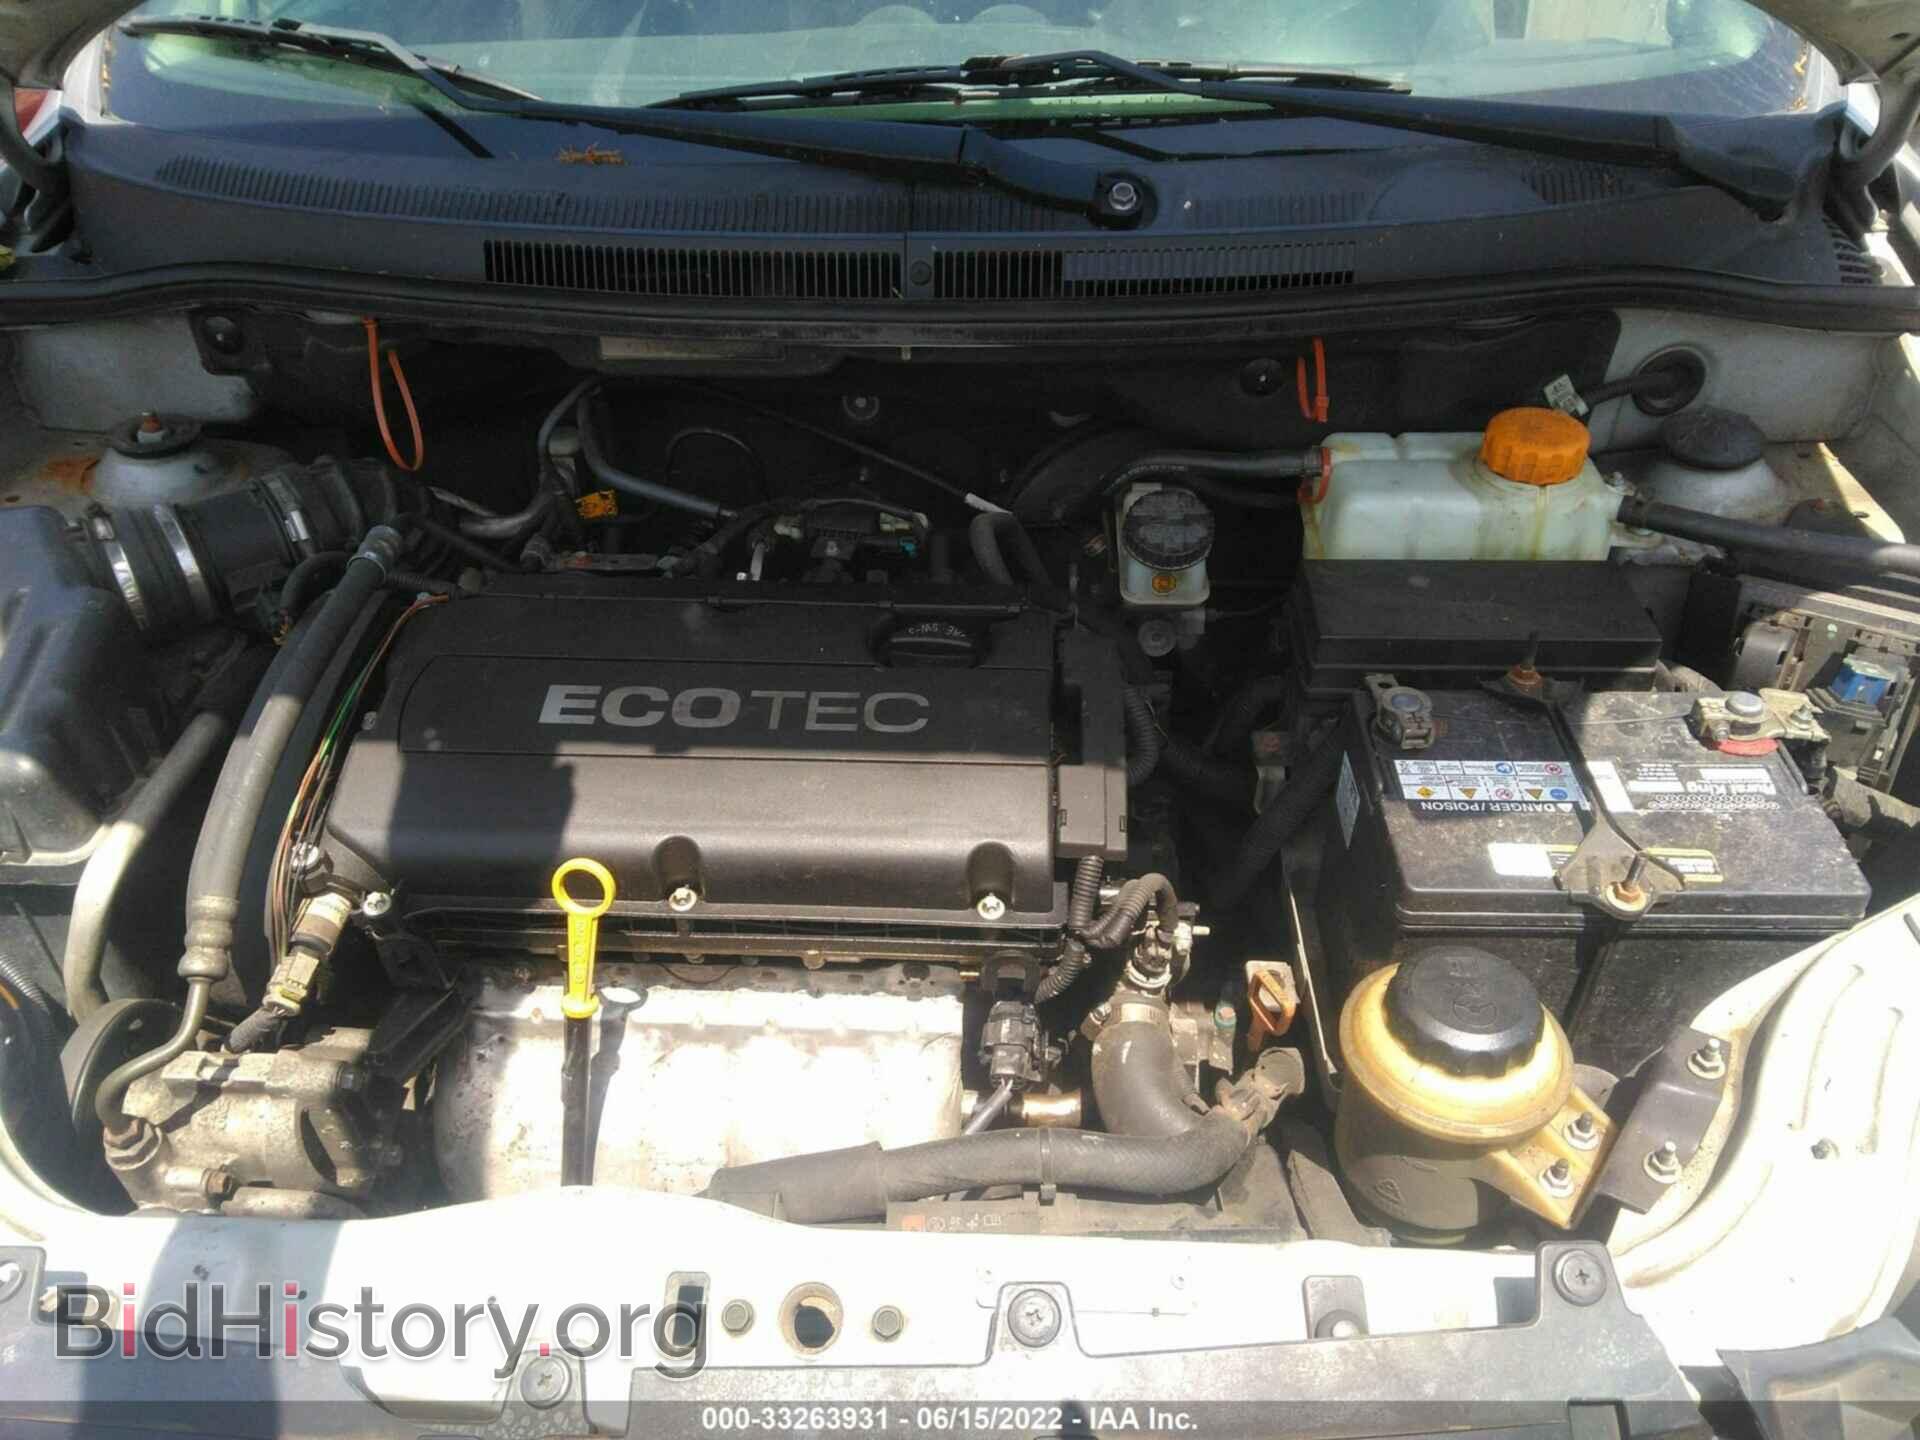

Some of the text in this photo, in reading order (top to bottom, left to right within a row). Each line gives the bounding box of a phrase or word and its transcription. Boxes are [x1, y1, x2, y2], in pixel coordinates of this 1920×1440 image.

[539, 683, 931, 734] ECOTEC
[1420, 801, 1480, 812] POISON
[1488, 801, 1556, 813] DANGER
